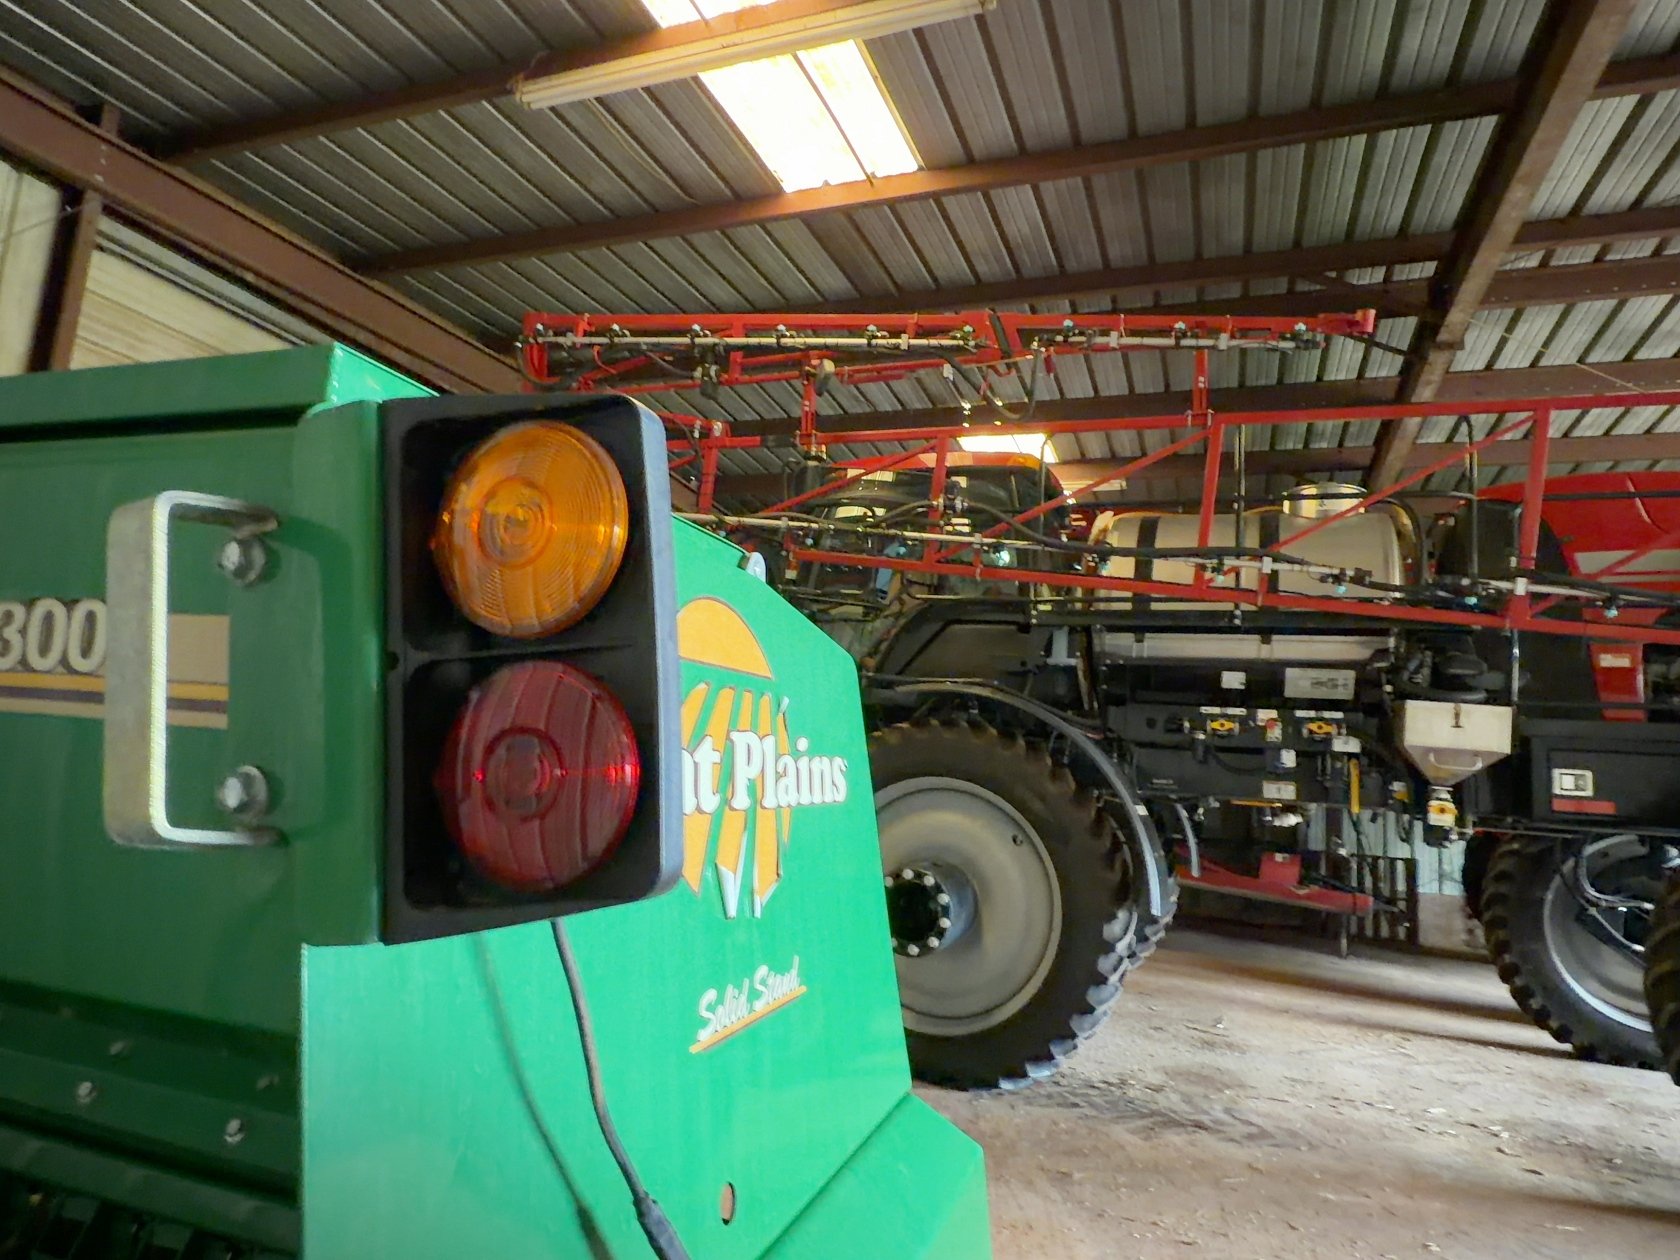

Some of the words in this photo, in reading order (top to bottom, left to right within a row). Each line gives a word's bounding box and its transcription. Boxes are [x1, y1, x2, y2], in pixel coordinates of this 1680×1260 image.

[729, 731, 848, 810] Plains
[696, 977, 750, 1042] Solid
[752, 954, 801, 1012] Steel
